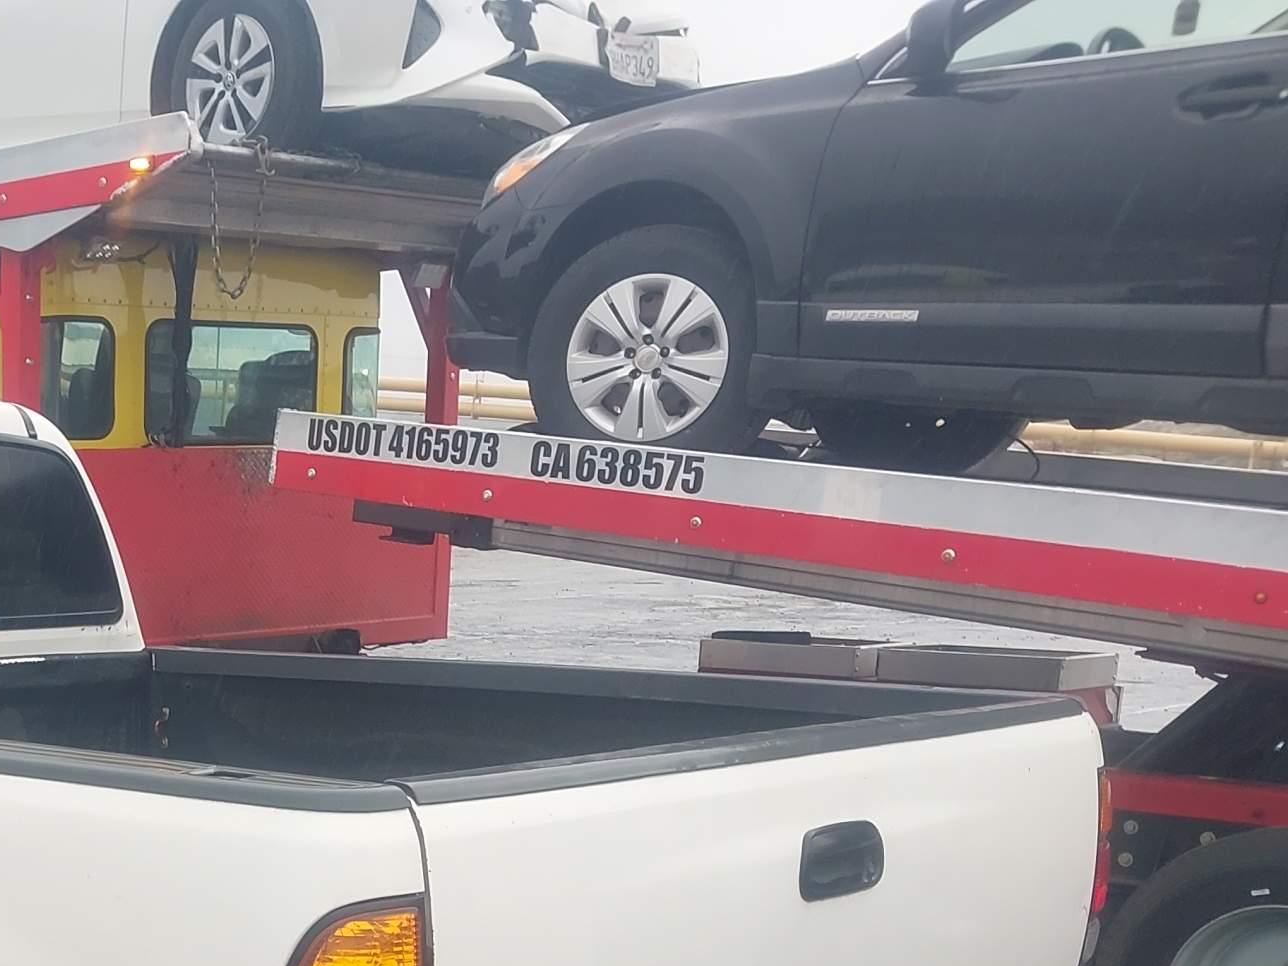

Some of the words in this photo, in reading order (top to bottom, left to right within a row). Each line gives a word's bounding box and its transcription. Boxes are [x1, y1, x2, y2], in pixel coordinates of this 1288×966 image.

[307, 418, 387, 458] USDOT
[388, 425, 499, 468] 4165973
[530, 440, 573, 480] CA
[576, 446, 705, 494] 638575
